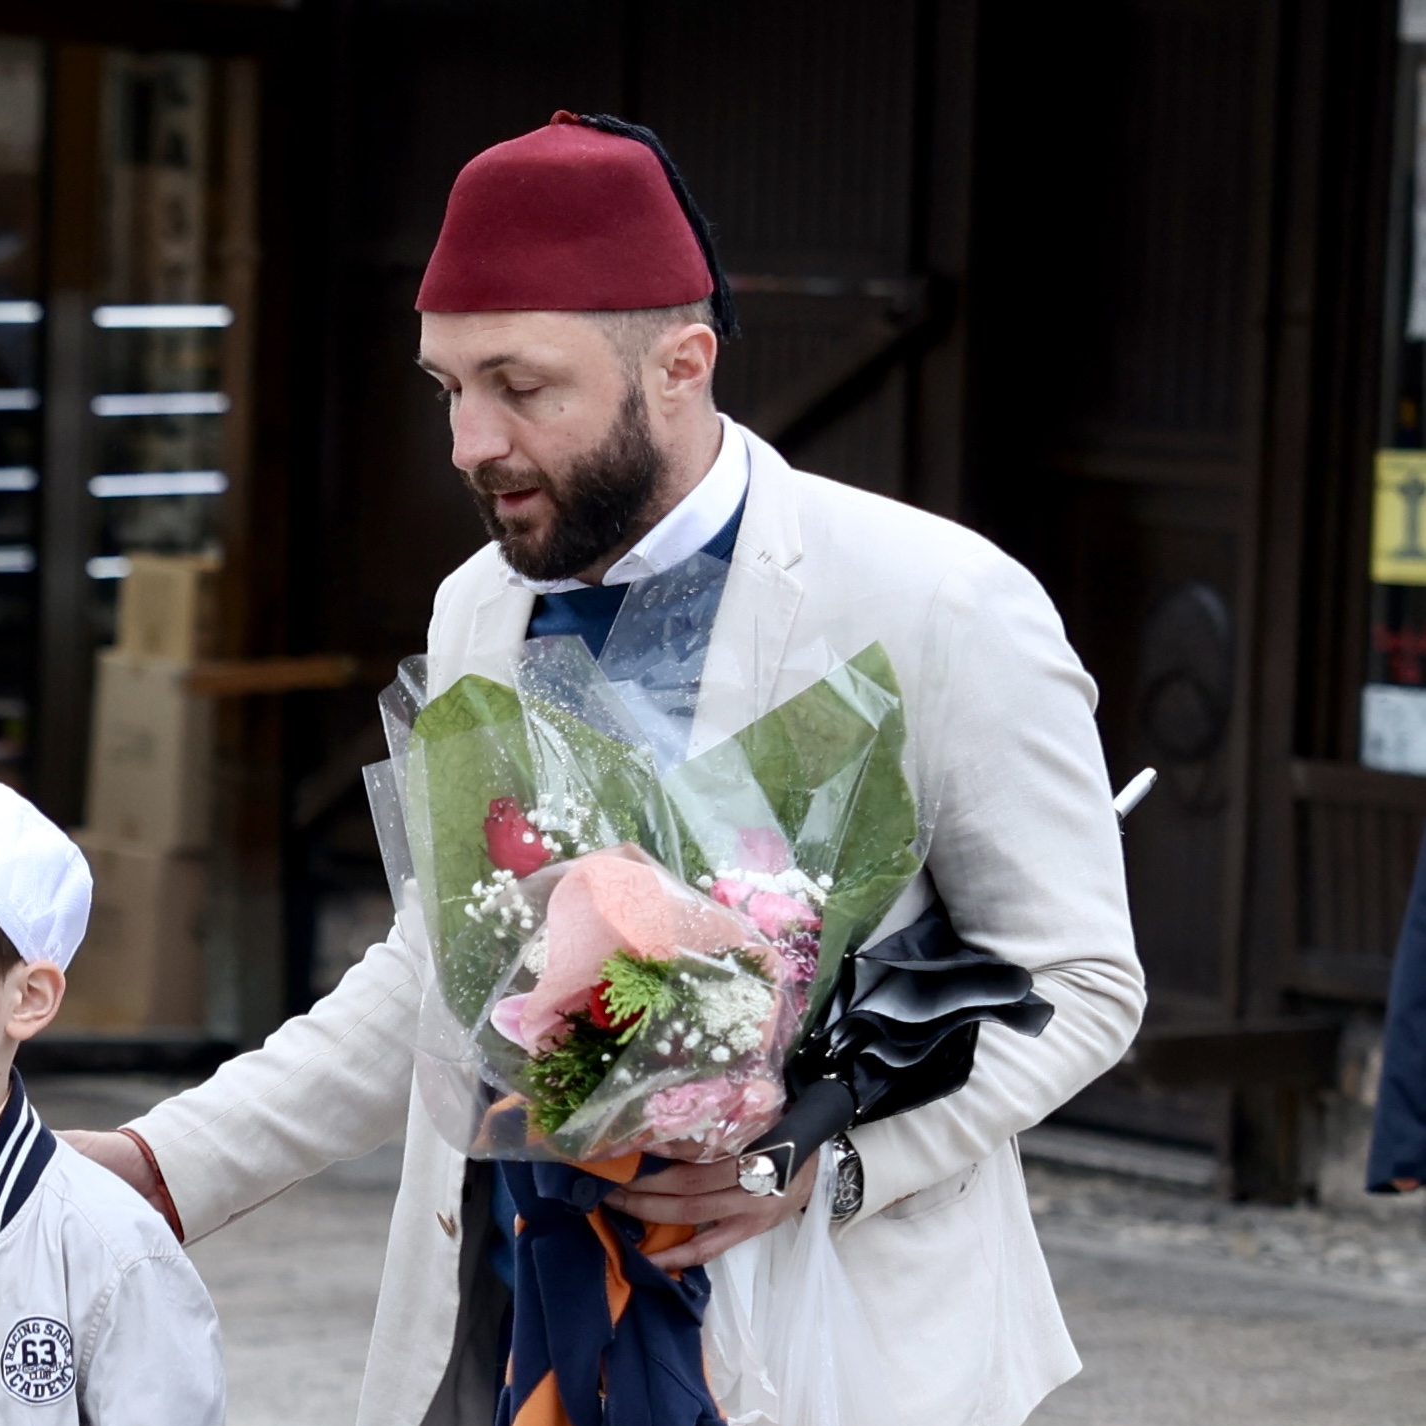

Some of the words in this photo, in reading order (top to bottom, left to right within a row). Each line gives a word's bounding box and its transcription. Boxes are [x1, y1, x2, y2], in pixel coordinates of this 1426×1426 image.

[5, 1323, 40, 1361] RACING
[21, 1339, 57, 1366] 63
[5, 1359, 74, 1398] ACADEMY
